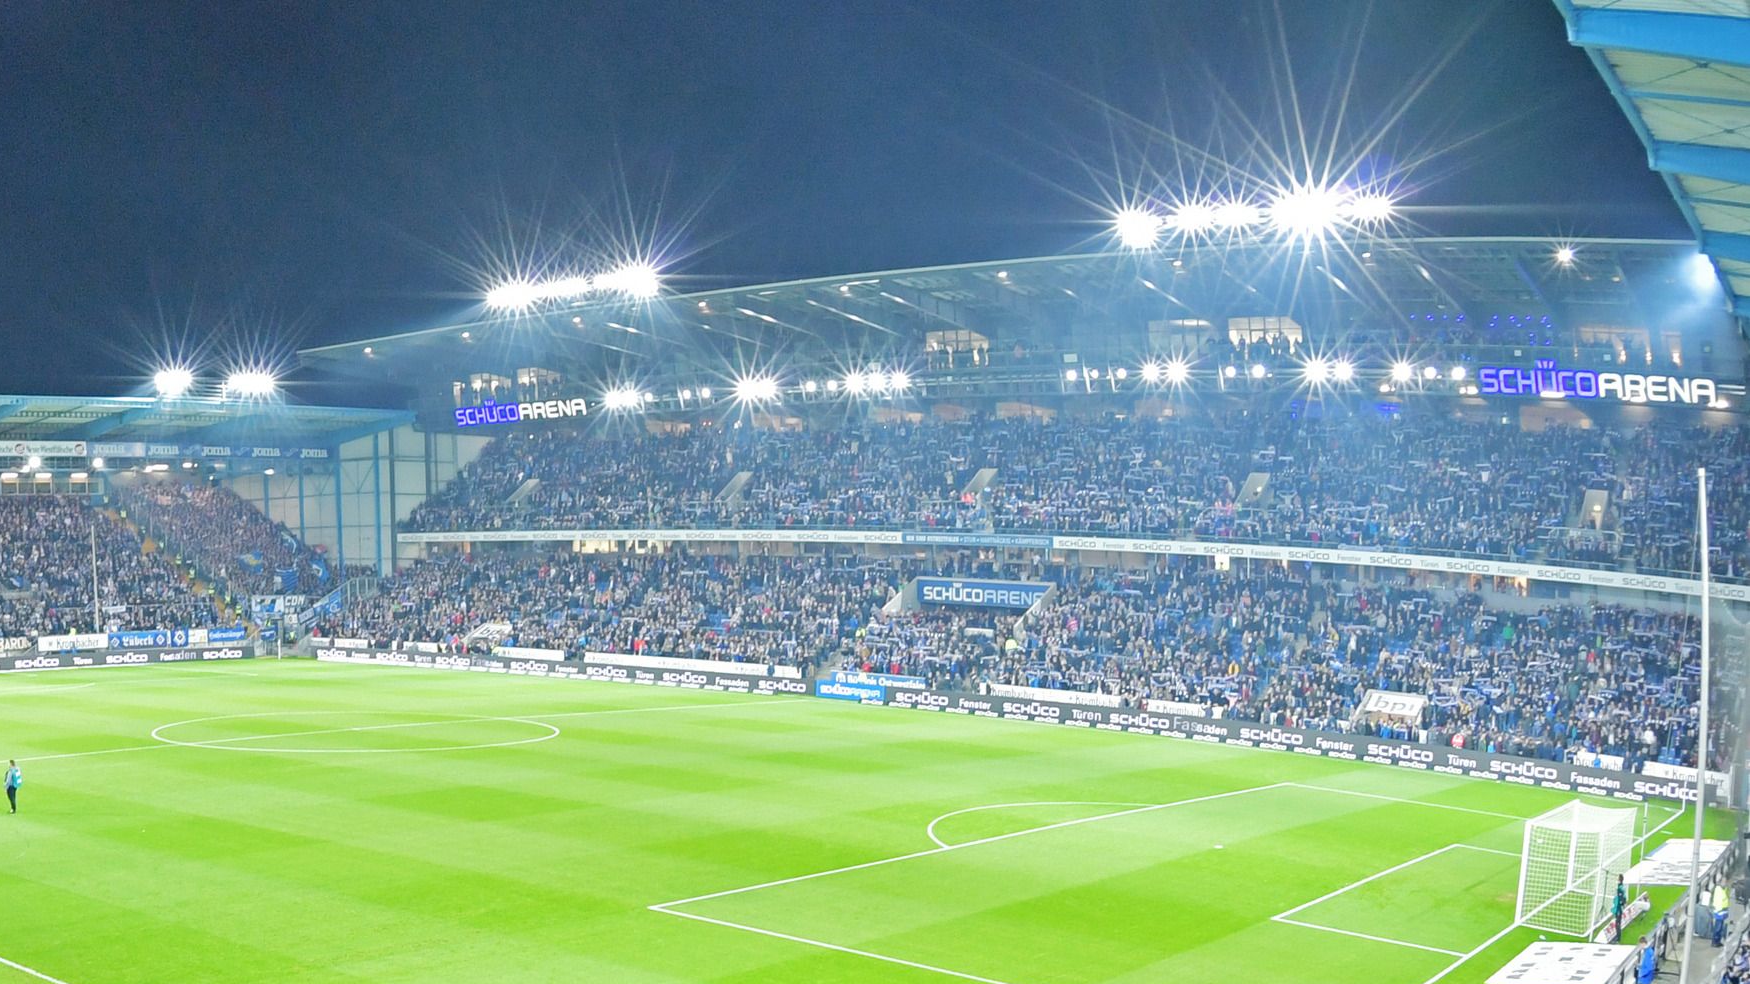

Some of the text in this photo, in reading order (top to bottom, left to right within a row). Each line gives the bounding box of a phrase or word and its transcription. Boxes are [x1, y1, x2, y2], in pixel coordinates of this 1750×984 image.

[1480, 360, 1717, 404] SCHÜCOARENA
[455, 399, 587, 426] SCHÜCOARENA
[1058, 539, 1096, 549] SCHÜCO
[1132, 541, 1172, 552] SCHÜCO
[1204, 545, 1244, 556] SCHÜCO
[1288, 550, 1330, 561] SCHÜCO
[1369, 555, 1411, 566] SCHÜCO
[1447, 561, 1490, 573] SCHÜCO
[1537, 569, 1581, 581] SCHÜCO
[1622, 577, 1667, 590] SCHÜCO
[1709, 586, 1746, 599] CHÜCO
[14, 656, 59, 669] SCHÜCO
[106, 653, 149, 664] SCHÜCO
[203, 648, 243, 660] SCHÜCO
[510, 660, 548, 672] SCHÜCO
[586, 665, 628, 679] SCHÜCO
[662, 671, 707, 685] SCHÜCO
[758, 679, 806, 693] SCHÜCO
[895, 691, 949, 706] SCHÜCO
[959, 697, 992, 711] Fenster
[1003, 702, 1060, 718] SCHÜCO
[1071, 708, 1101, 721] Türen
[1109, 713, 1170, 730] SCHÜCO
[1239, 728, 1303, 746] SCHÜCO
[1316, 737, 1354, 752] Fenster
[1367, 743, 1434, 763] SCHÜCO
[1447, 753, 1477, 768] Türen
[1489, 760, 1558, 781] SCHÜCO
[1570, 771, 1621, 789] Fassaden
